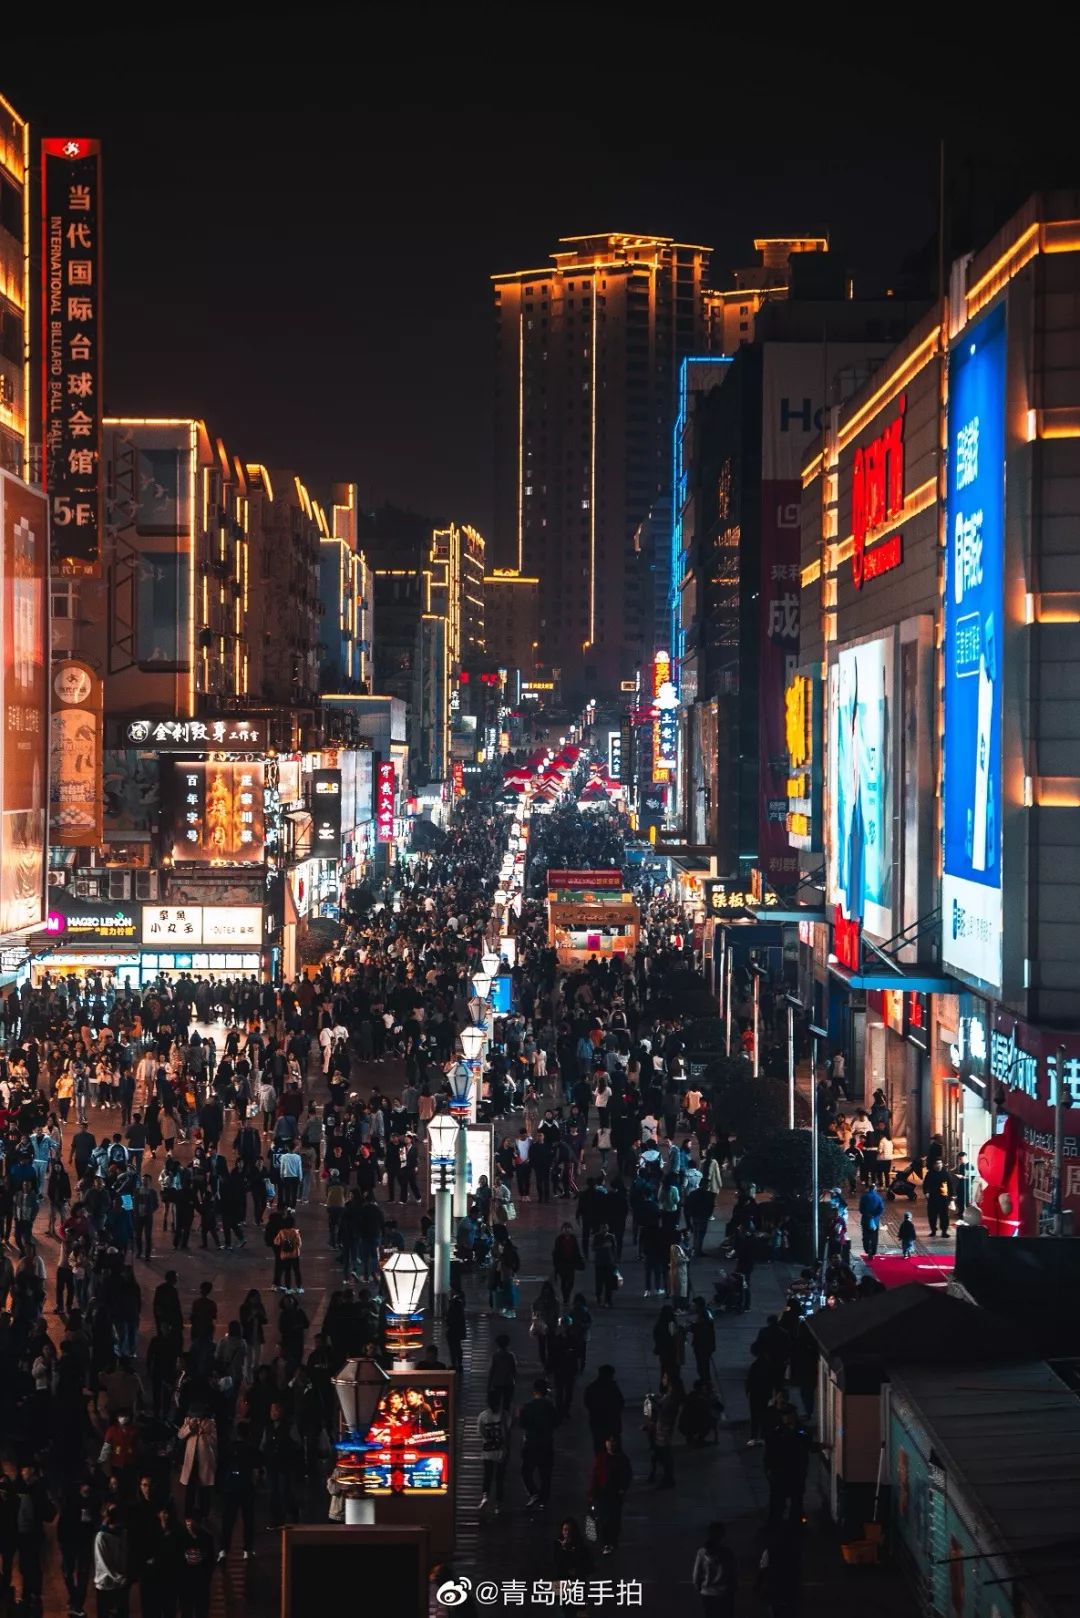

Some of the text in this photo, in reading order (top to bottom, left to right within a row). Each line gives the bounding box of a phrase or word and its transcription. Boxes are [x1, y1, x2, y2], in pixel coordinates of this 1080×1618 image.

[51, 216, 61, 313] INTERNATIONAL
[67, 185, 93, 475] 当代国际台球会馆
[51, 321, 61, 376] BILLIARD
[51, 382, 61, 413] BALL
[54, 497, 90, 527] 5F
[229, 731, 260, 742] 工作室
[186, 774, 199, 842] 百年字号
[48, 918, 59, 930] M
[100, 917, 131, 926] LEMON
[150, 923, 194, 934] 小丸子
